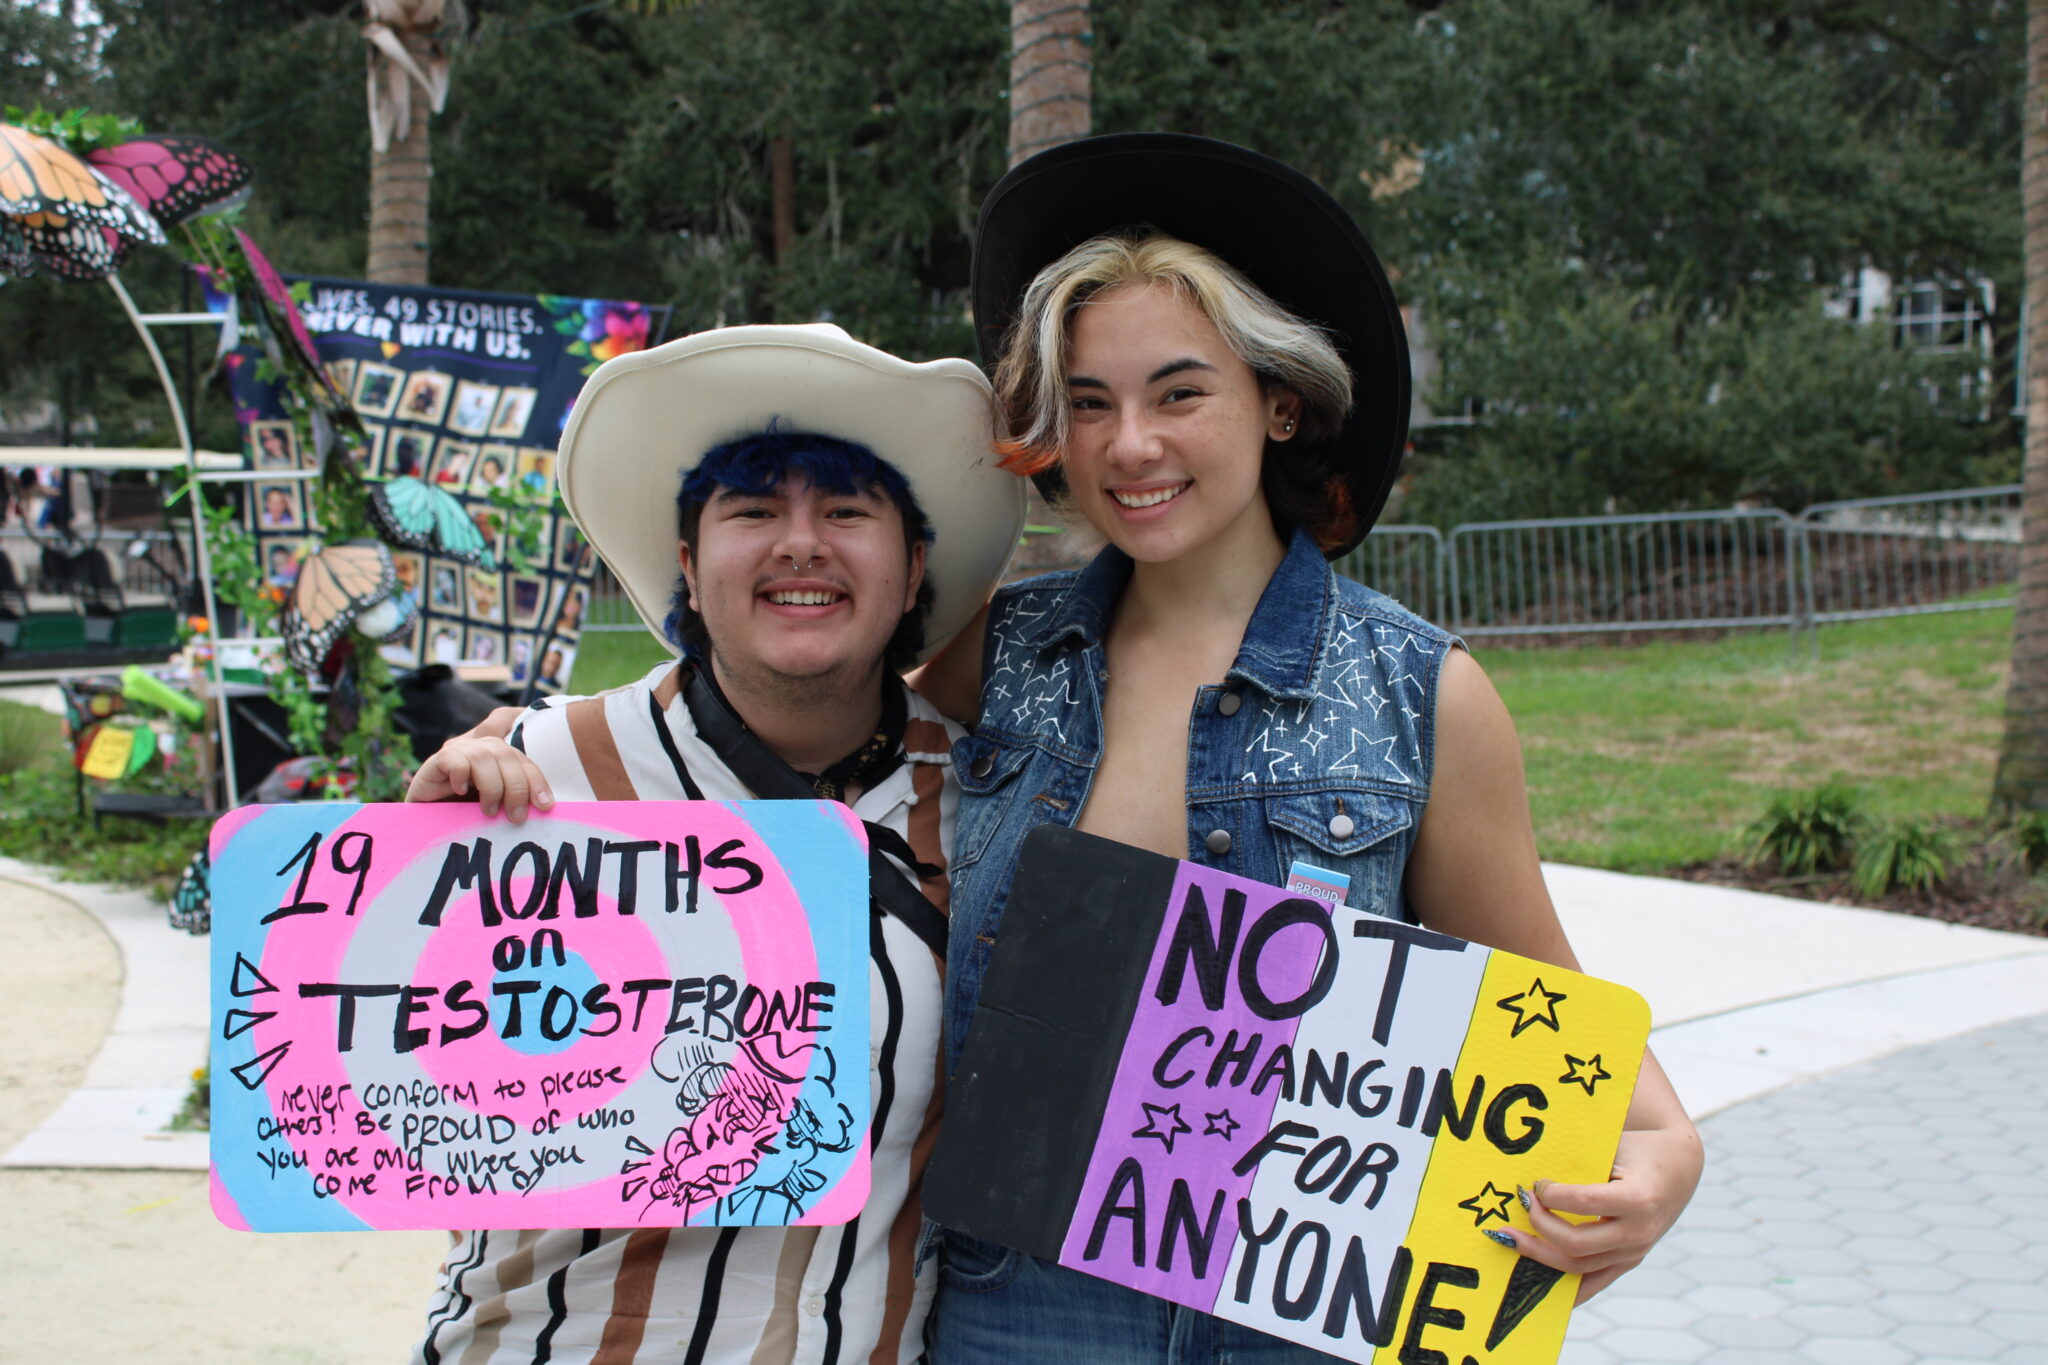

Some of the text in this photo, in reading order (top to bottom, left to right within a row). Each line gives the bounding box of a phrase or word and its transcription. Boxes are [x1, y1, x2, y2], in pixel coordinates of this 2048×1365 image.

[384, 296, 418, 322] 49
[426, 300, 543, 335] STORIES.
[400, 323, 477, 352] WITH
[486, 331, 532, 359] US.
[260, 831, 764, 927] 19 MONTHS
[1295, 881, 1339, 902] PROUD
[492, 928, 566, 972] on
[1154, 882, 1472, 1047] NOT
[298, 974, 836, 1054] TESTOSTERONE
[494, 1080, 525, 1100] to
[541, 1066, 627, 1107] please
[1152, 1026, 1549, 1155] CHANGING
[355, 1111, 392, 1135] Be
[402, 1113, 516, 1150] PROUD
[532, 1109, 560, 1135] of
[578, 1108, 635, 1129] who
[325, 1147, 359, 1168] are
[374, 1143, 424, 1172] and
[530, 1145, 585, 1174] you
[1232, 1119, 1399, 1210] FOR
[313, 1172, 377, 1198] come
[1082, 1157, 1568, 1365] ANYONE!
